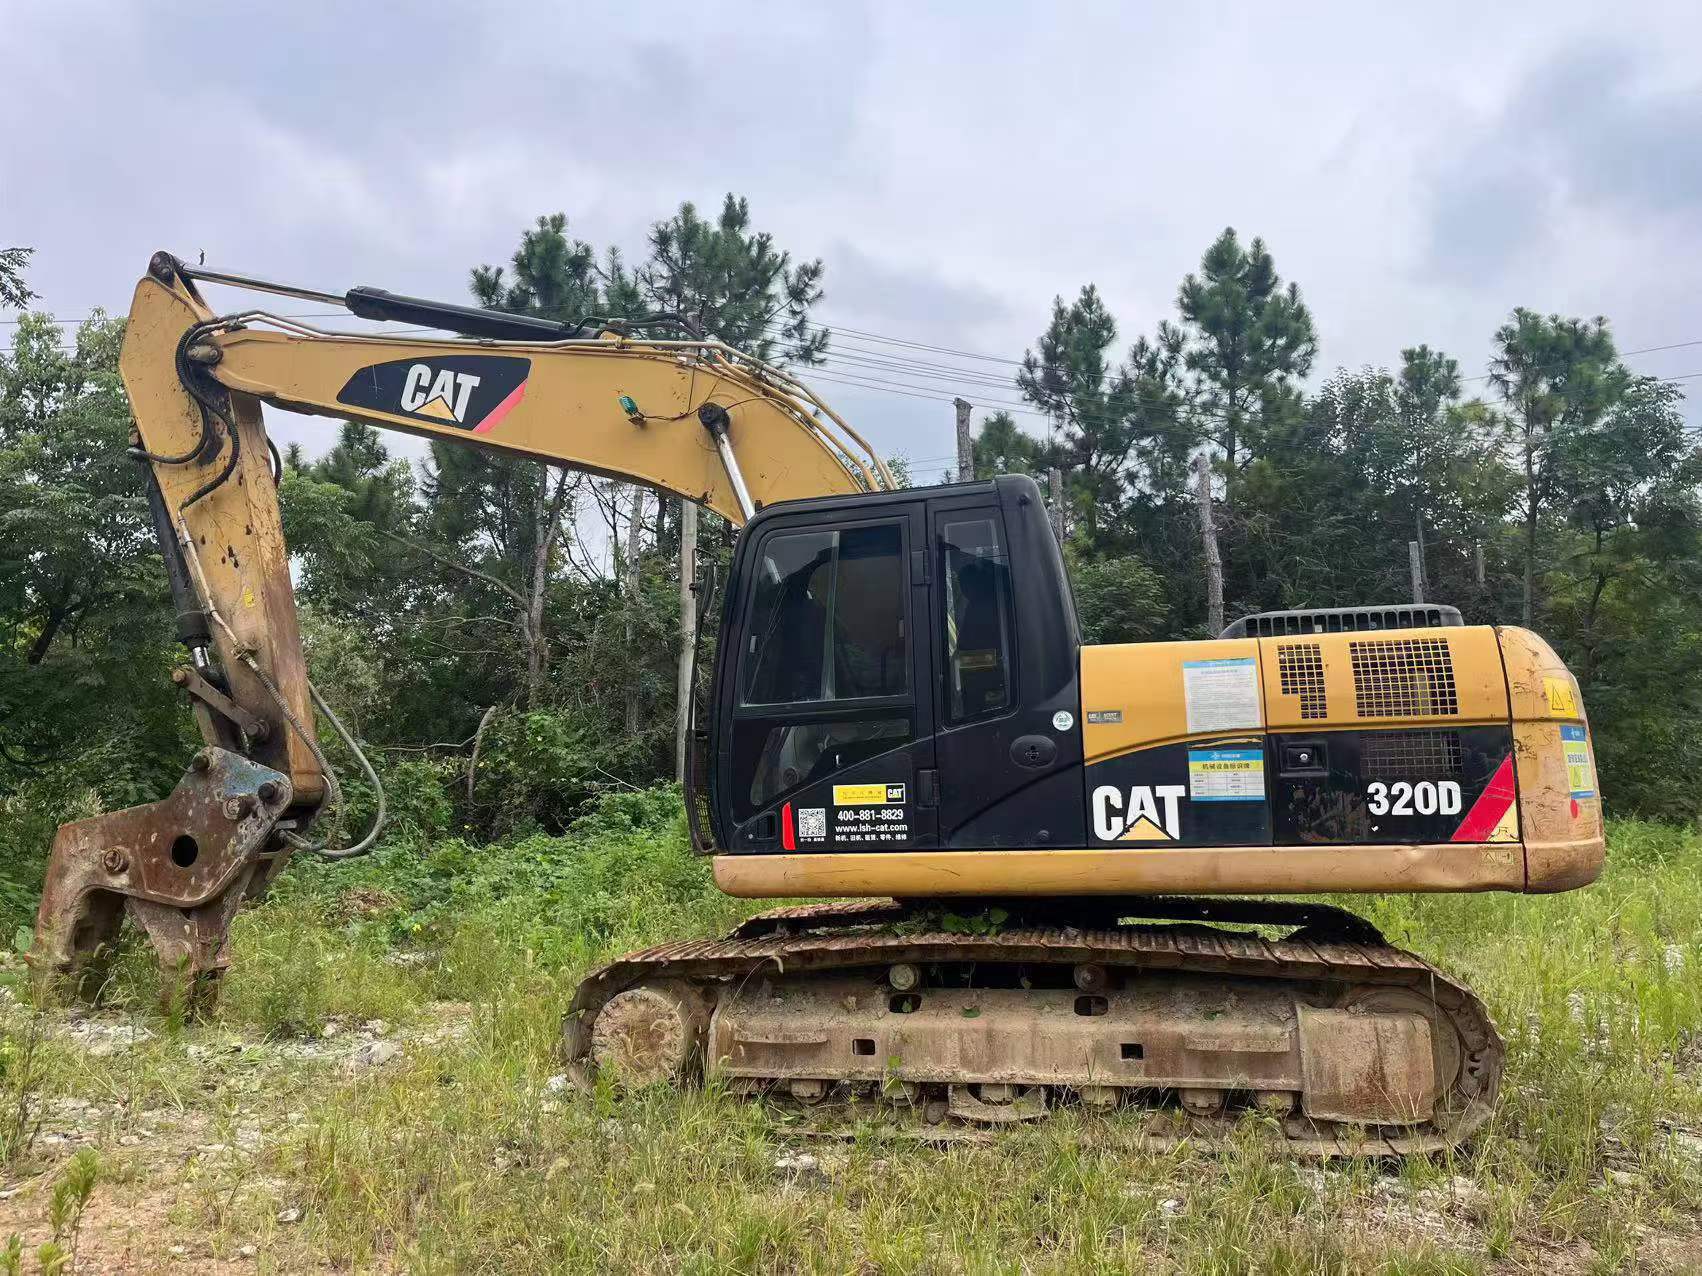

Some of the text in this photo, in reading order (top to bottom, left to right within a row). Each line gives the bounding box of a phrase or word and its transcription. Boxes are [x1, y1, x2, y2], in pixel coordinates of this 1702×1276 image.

[400, 363, 481, 423] CAT
[888, 789, 902, 798] CAT
[1367, 780, 1462, 816] 320D
[837, 809, 904, 821] 400-881-8829
[1092, 785, 1186, 841] CAT
[835, 823, 908, 833] www.lsh-cat.com
